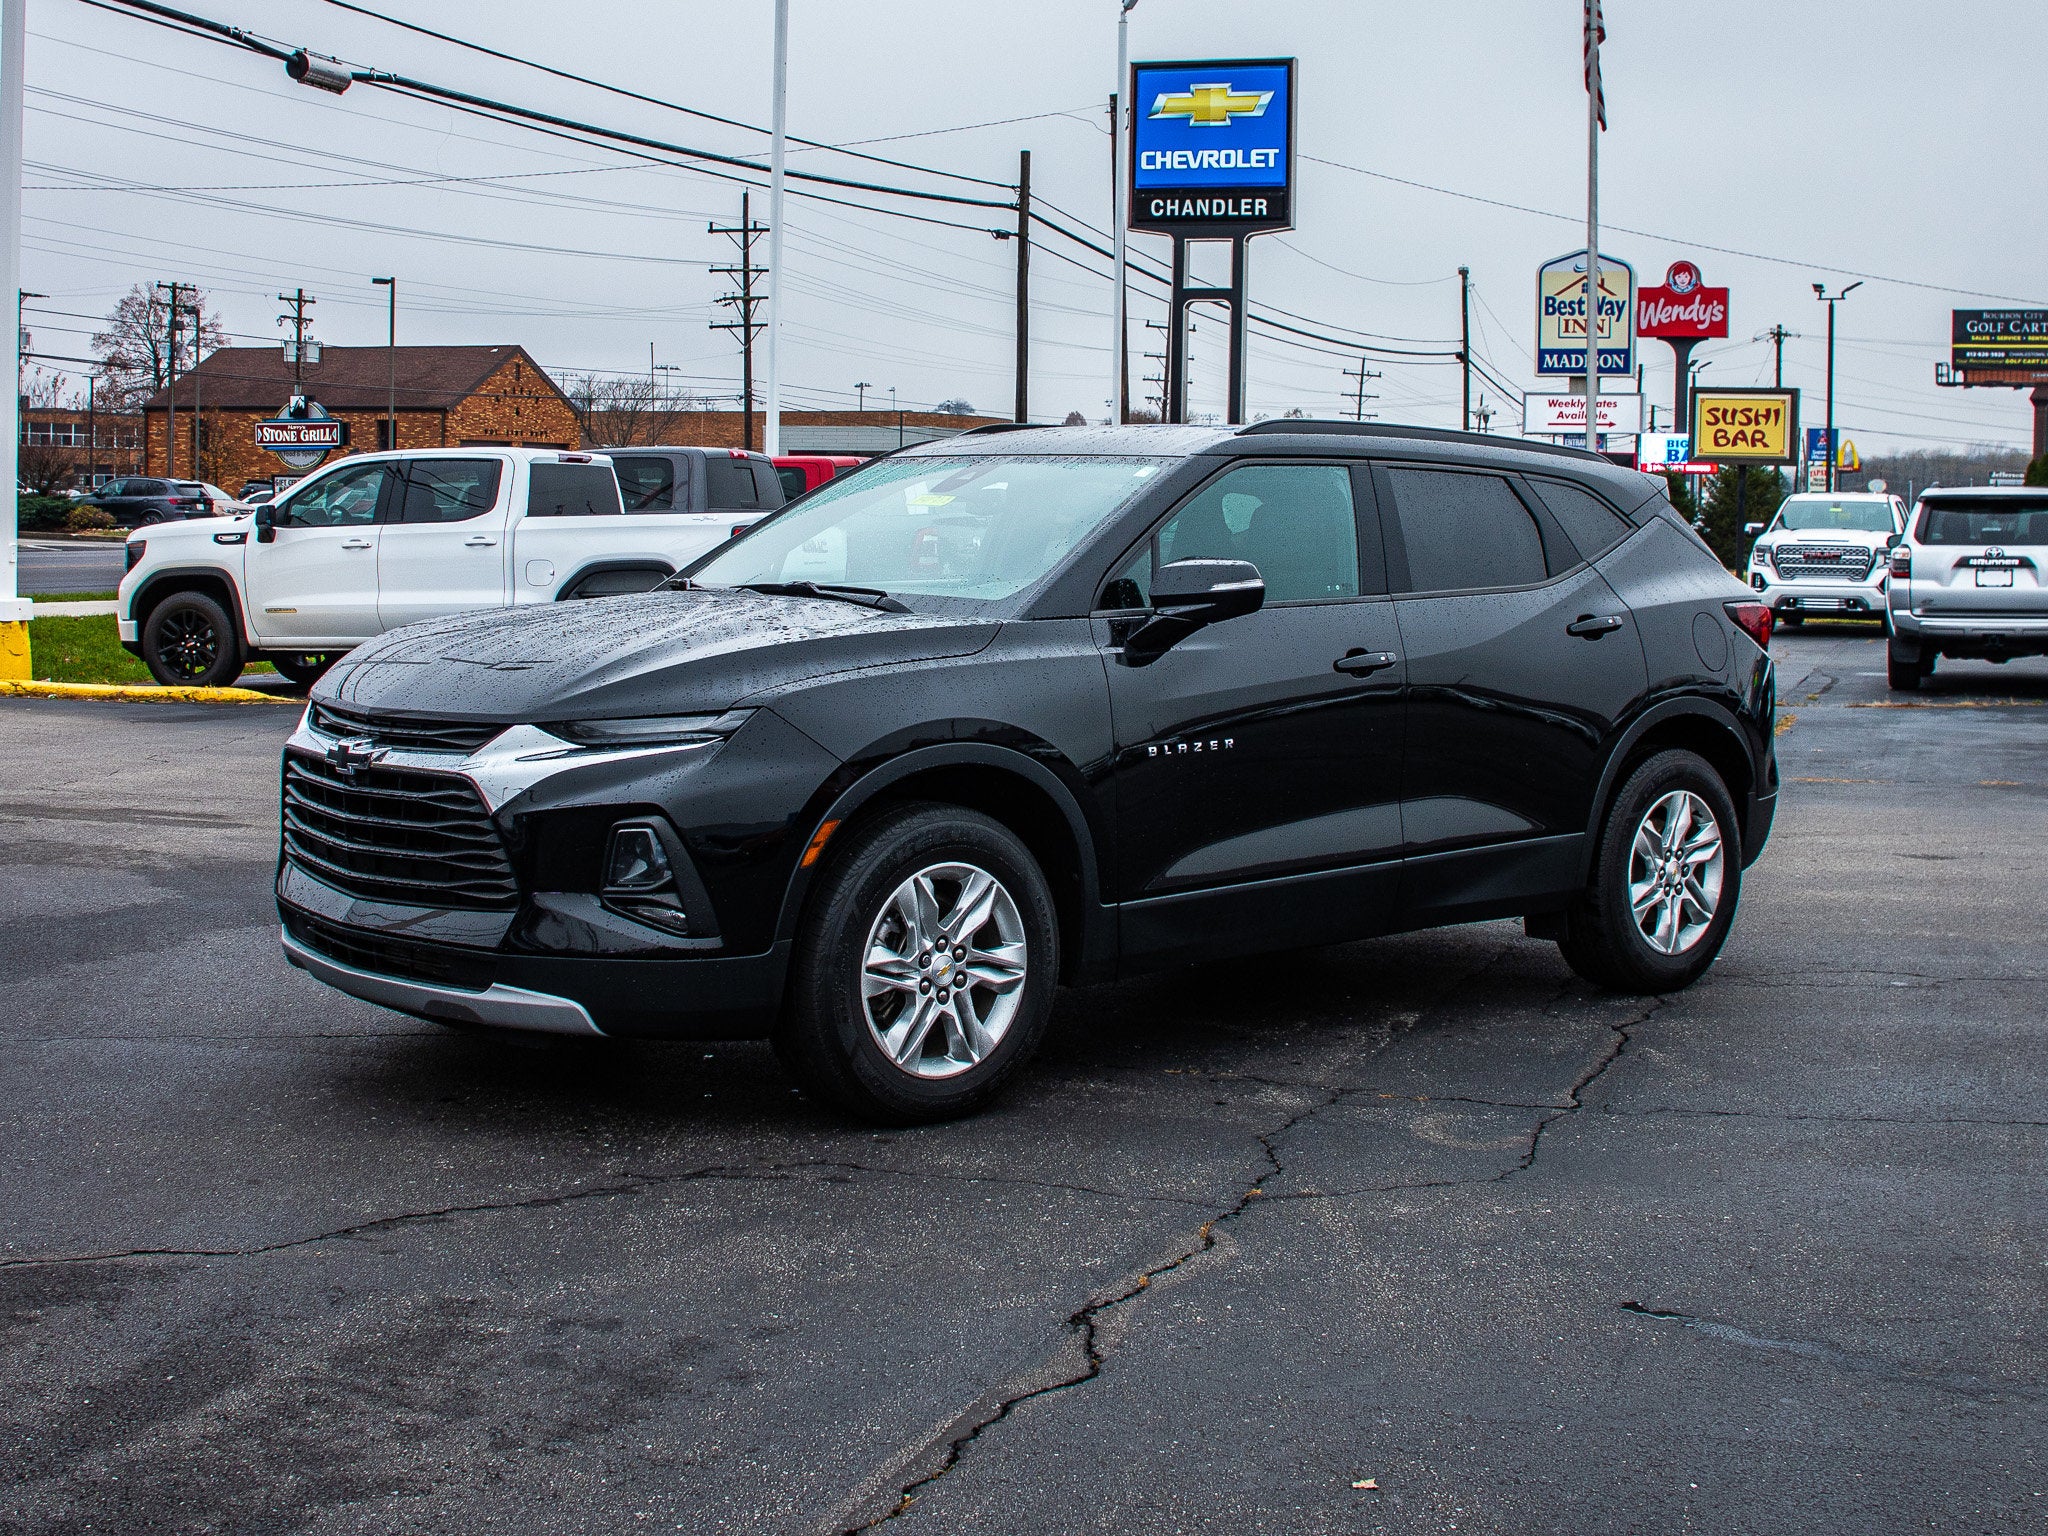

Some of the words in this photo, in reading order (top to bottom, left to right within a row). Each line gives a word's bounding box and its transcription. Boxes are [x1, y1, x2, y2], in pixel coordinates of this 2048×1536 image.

[1140, 148, 1280, 170] CHEVROLET
[1150, 199, 1268, 216] CHANDLER
[1640, 293, 1725, 330] Wendy's
[1966, 320, 2005, 333] GOLF
[1543, 353, 1626, 369] MADION
[1547, 398, 1586, 410] Weekly
[1595, 399, 1618, 408] ates
[1705, 407, 1781, 427] SUSHI
[263, 427, 297, 441] STONE
[300, 428, 332, 441] GRILL
[1713, 428, 1770, 448] BAR
[1147, 738, 1235, 757] BLAZER
